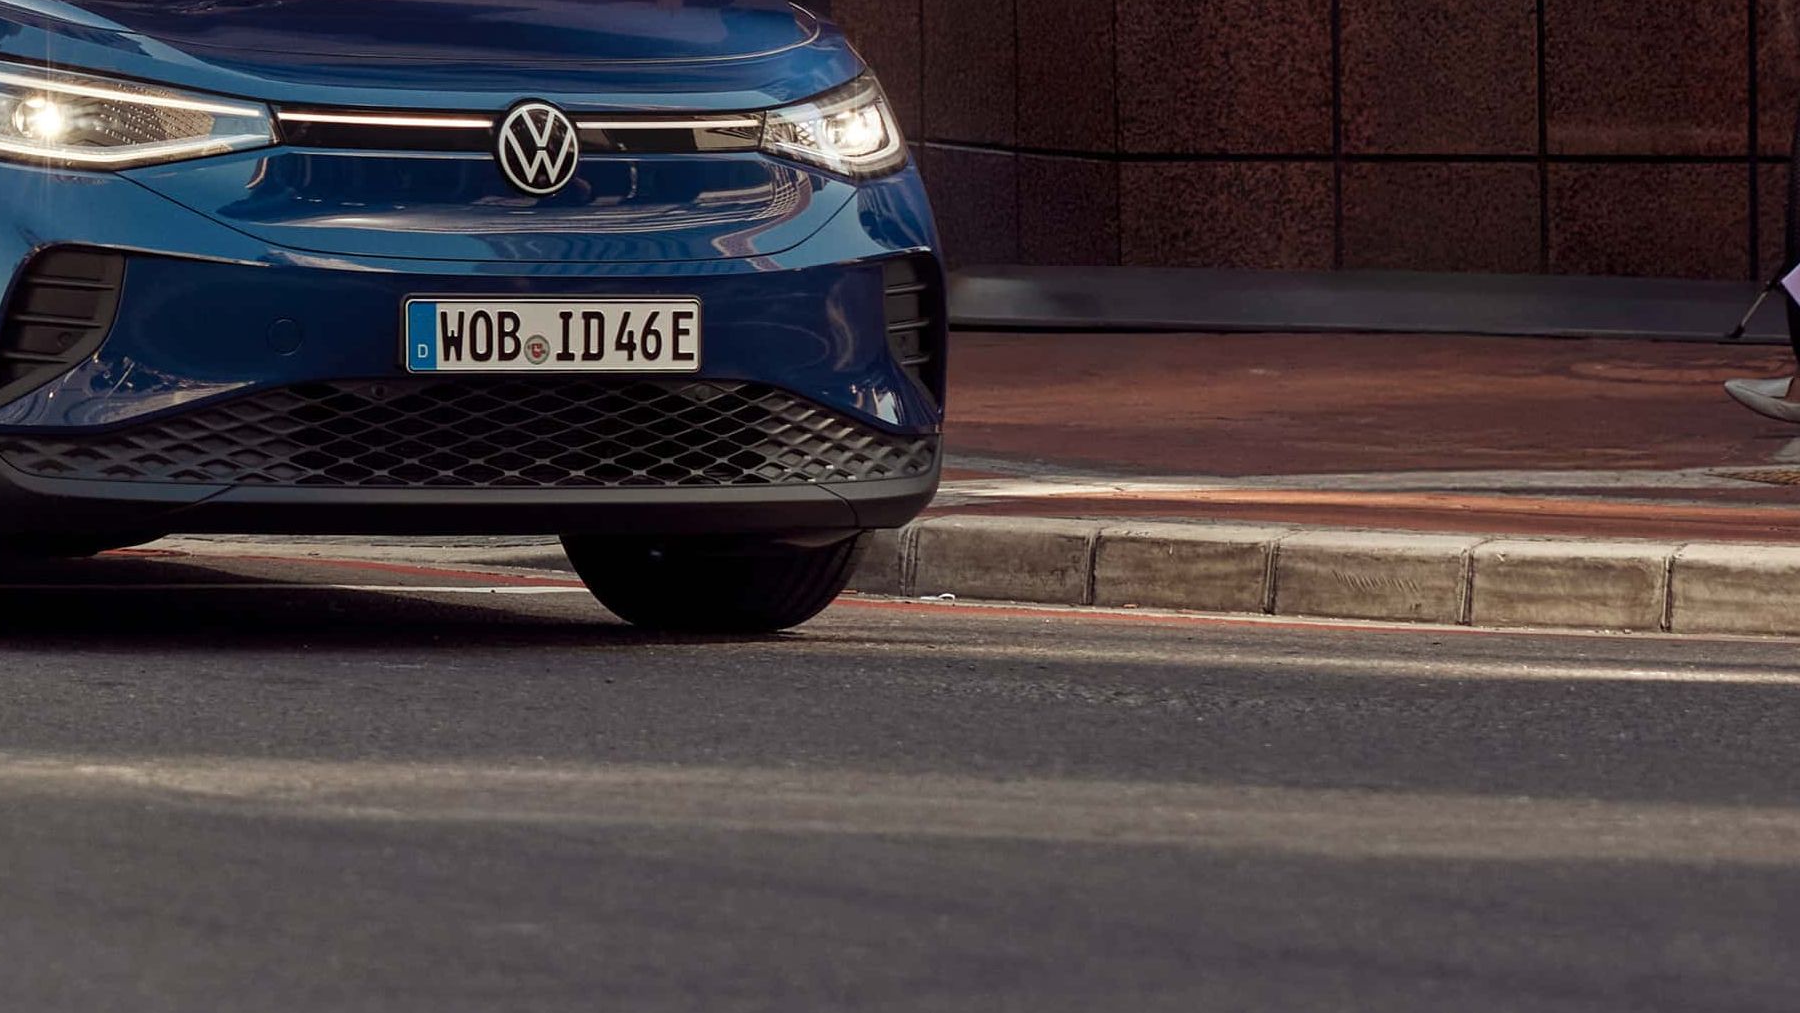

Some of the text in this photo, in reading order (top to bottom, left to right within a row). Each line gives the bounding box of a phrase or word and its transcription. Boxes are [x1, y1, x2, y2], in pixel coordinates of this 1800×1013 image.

[500, 104, 578, 193] VW
[417, 344, 429, 359] D
[440, 310, 522, 362] WOB
